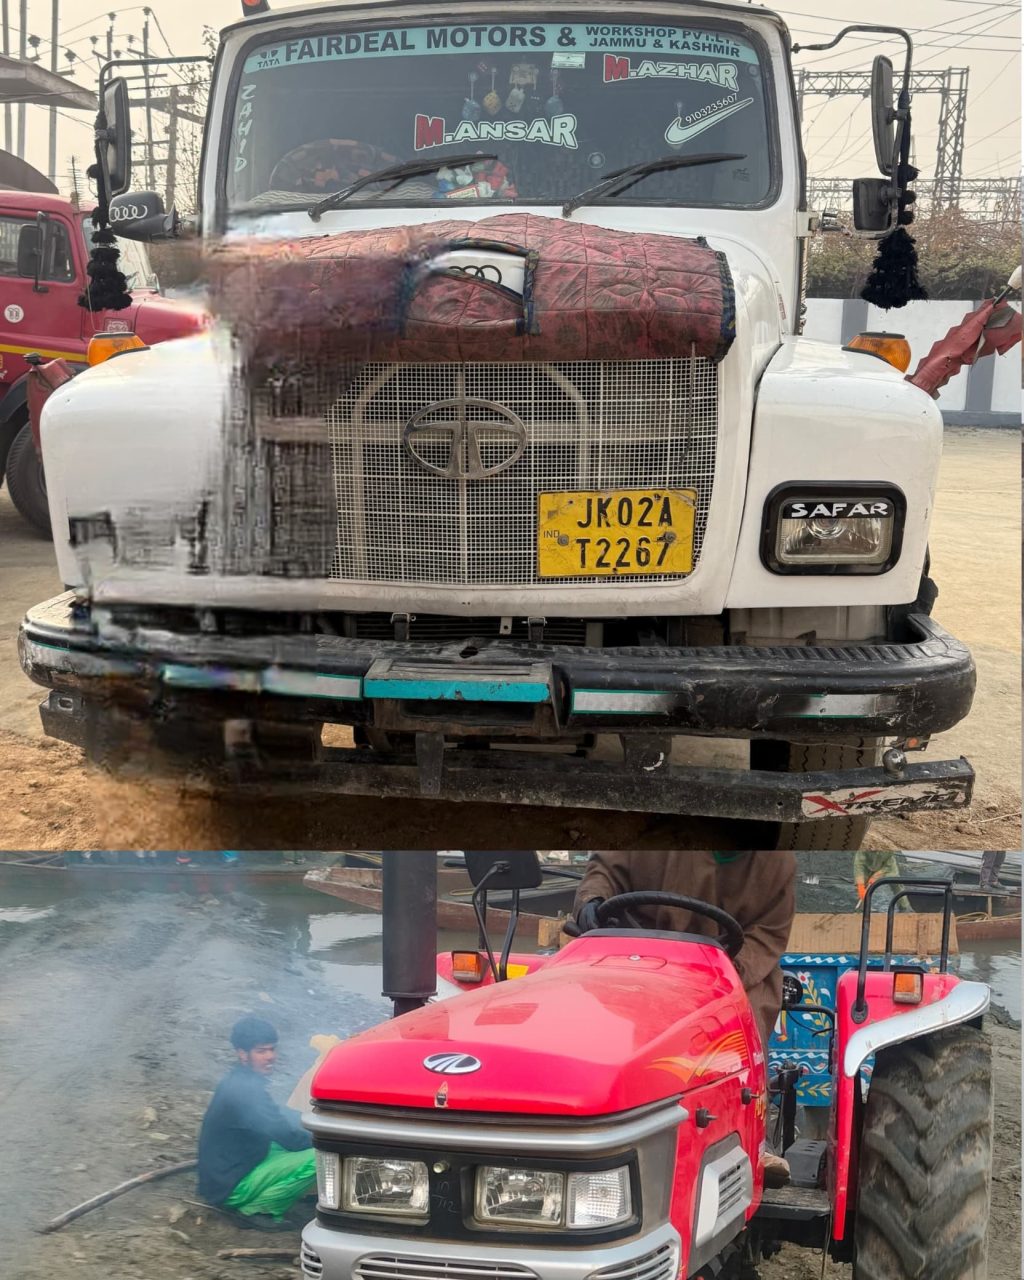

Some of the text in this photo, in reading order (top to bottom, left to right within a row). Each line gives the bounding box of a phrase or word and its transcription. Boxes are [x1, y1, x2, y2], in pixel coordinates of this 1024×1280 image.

[285, 26, 577, 62] FAIRDEAL MOTORS &
[586, 26, 677, 38] WORKSHOP
[589, 37, 741, 58] JAMMU & KASHMIR
[257, 58, 280, 69] TATA
[603, 53, 740, 93] M.AZHAR
[685, 92, 739, 124] 9103235607
[414, 113, 579, 151] M.ANSAR
[577, 496, 673, 528] JK02A
[791, 501, 888, 519] SAFAR
[543, 530, 560, 539] IND
[575, 536, 677, 569] T2267
